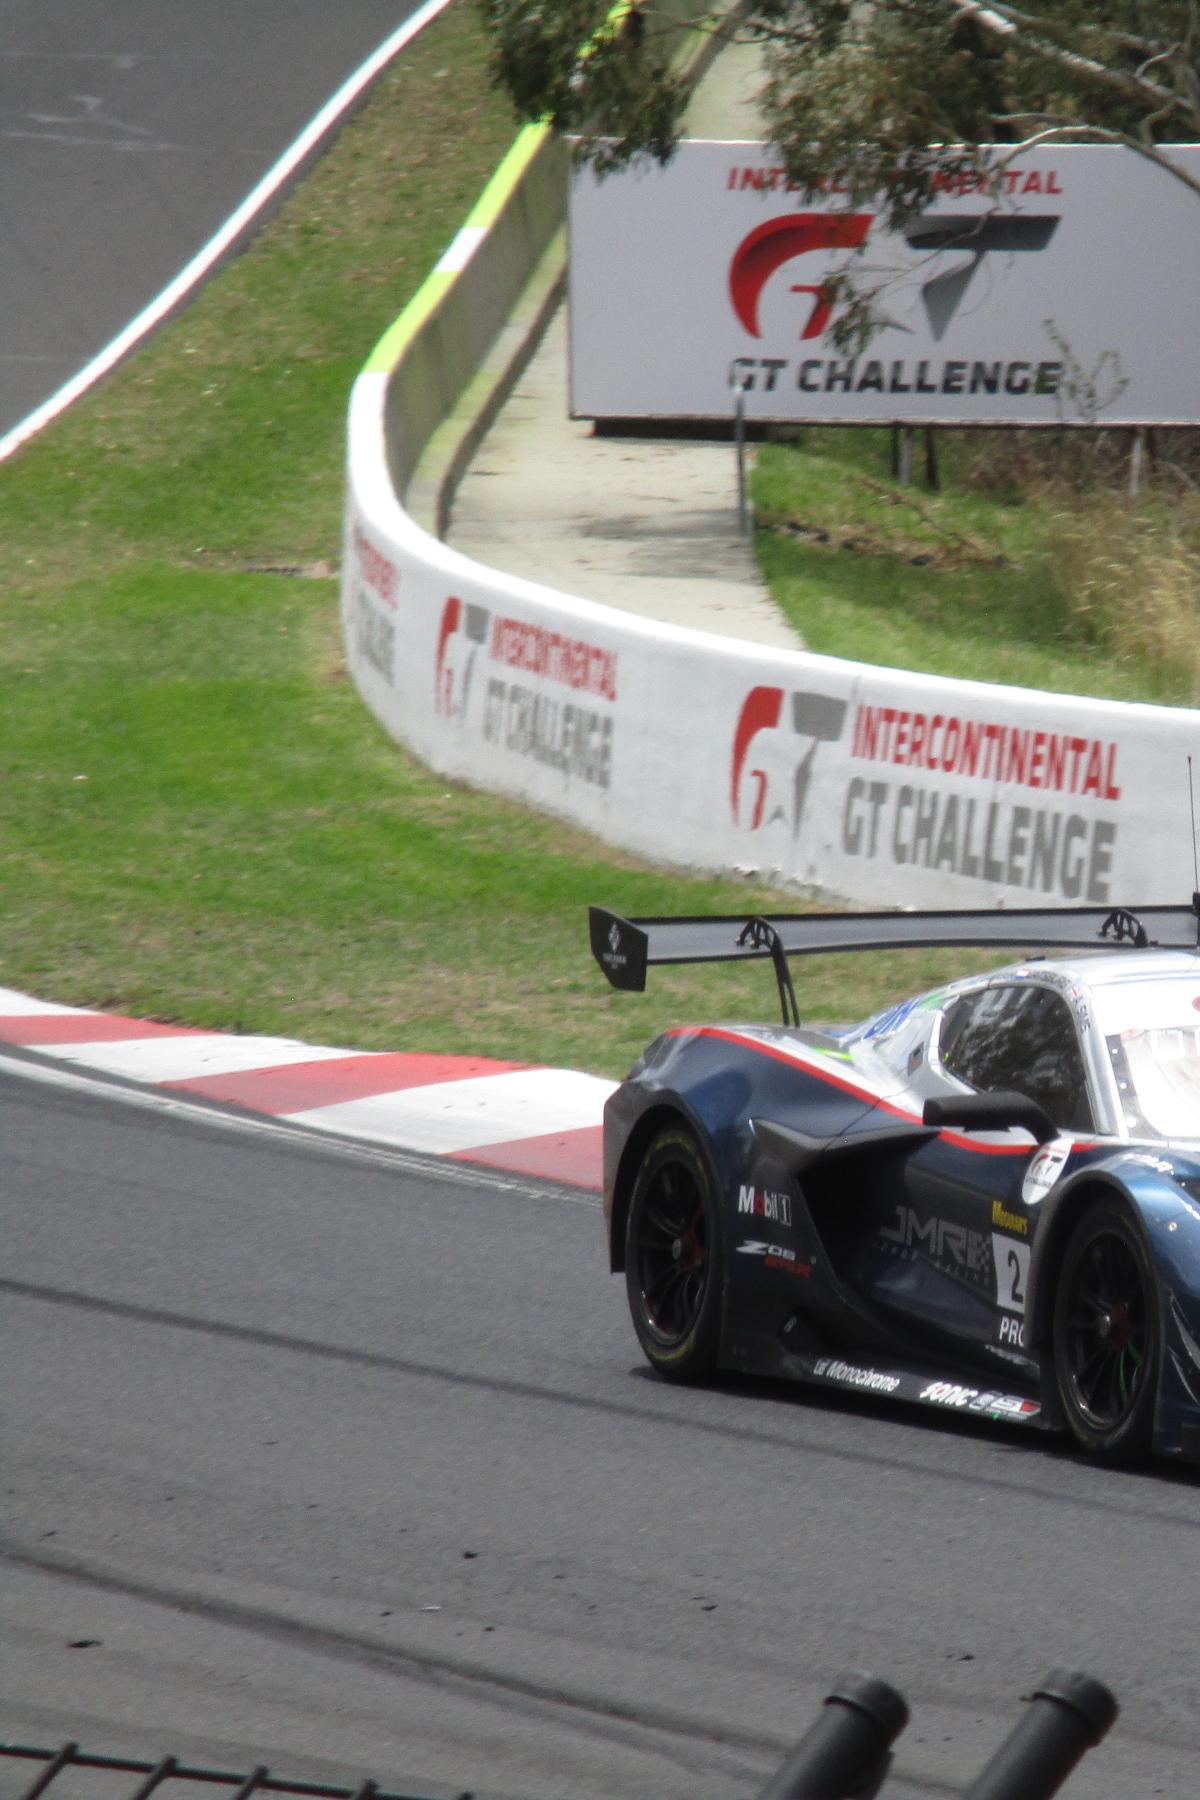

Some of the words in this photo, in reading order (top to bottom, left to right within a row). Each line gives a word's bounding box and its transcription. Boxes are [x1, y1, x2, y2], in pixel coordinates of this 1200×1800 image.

[730, 357, 788, 392] GT
[798, 359, 1062, 395] CHALLENGE
[851, 703, 1122, 800] INTERCONTINENTAL
[842, 776, 888, 857] GT
[892, 785, 1118, 902] CHALLENGE
[738, 1184, 778, 1221] Mobil
[1007, 1249, 1025, 1304] 2
